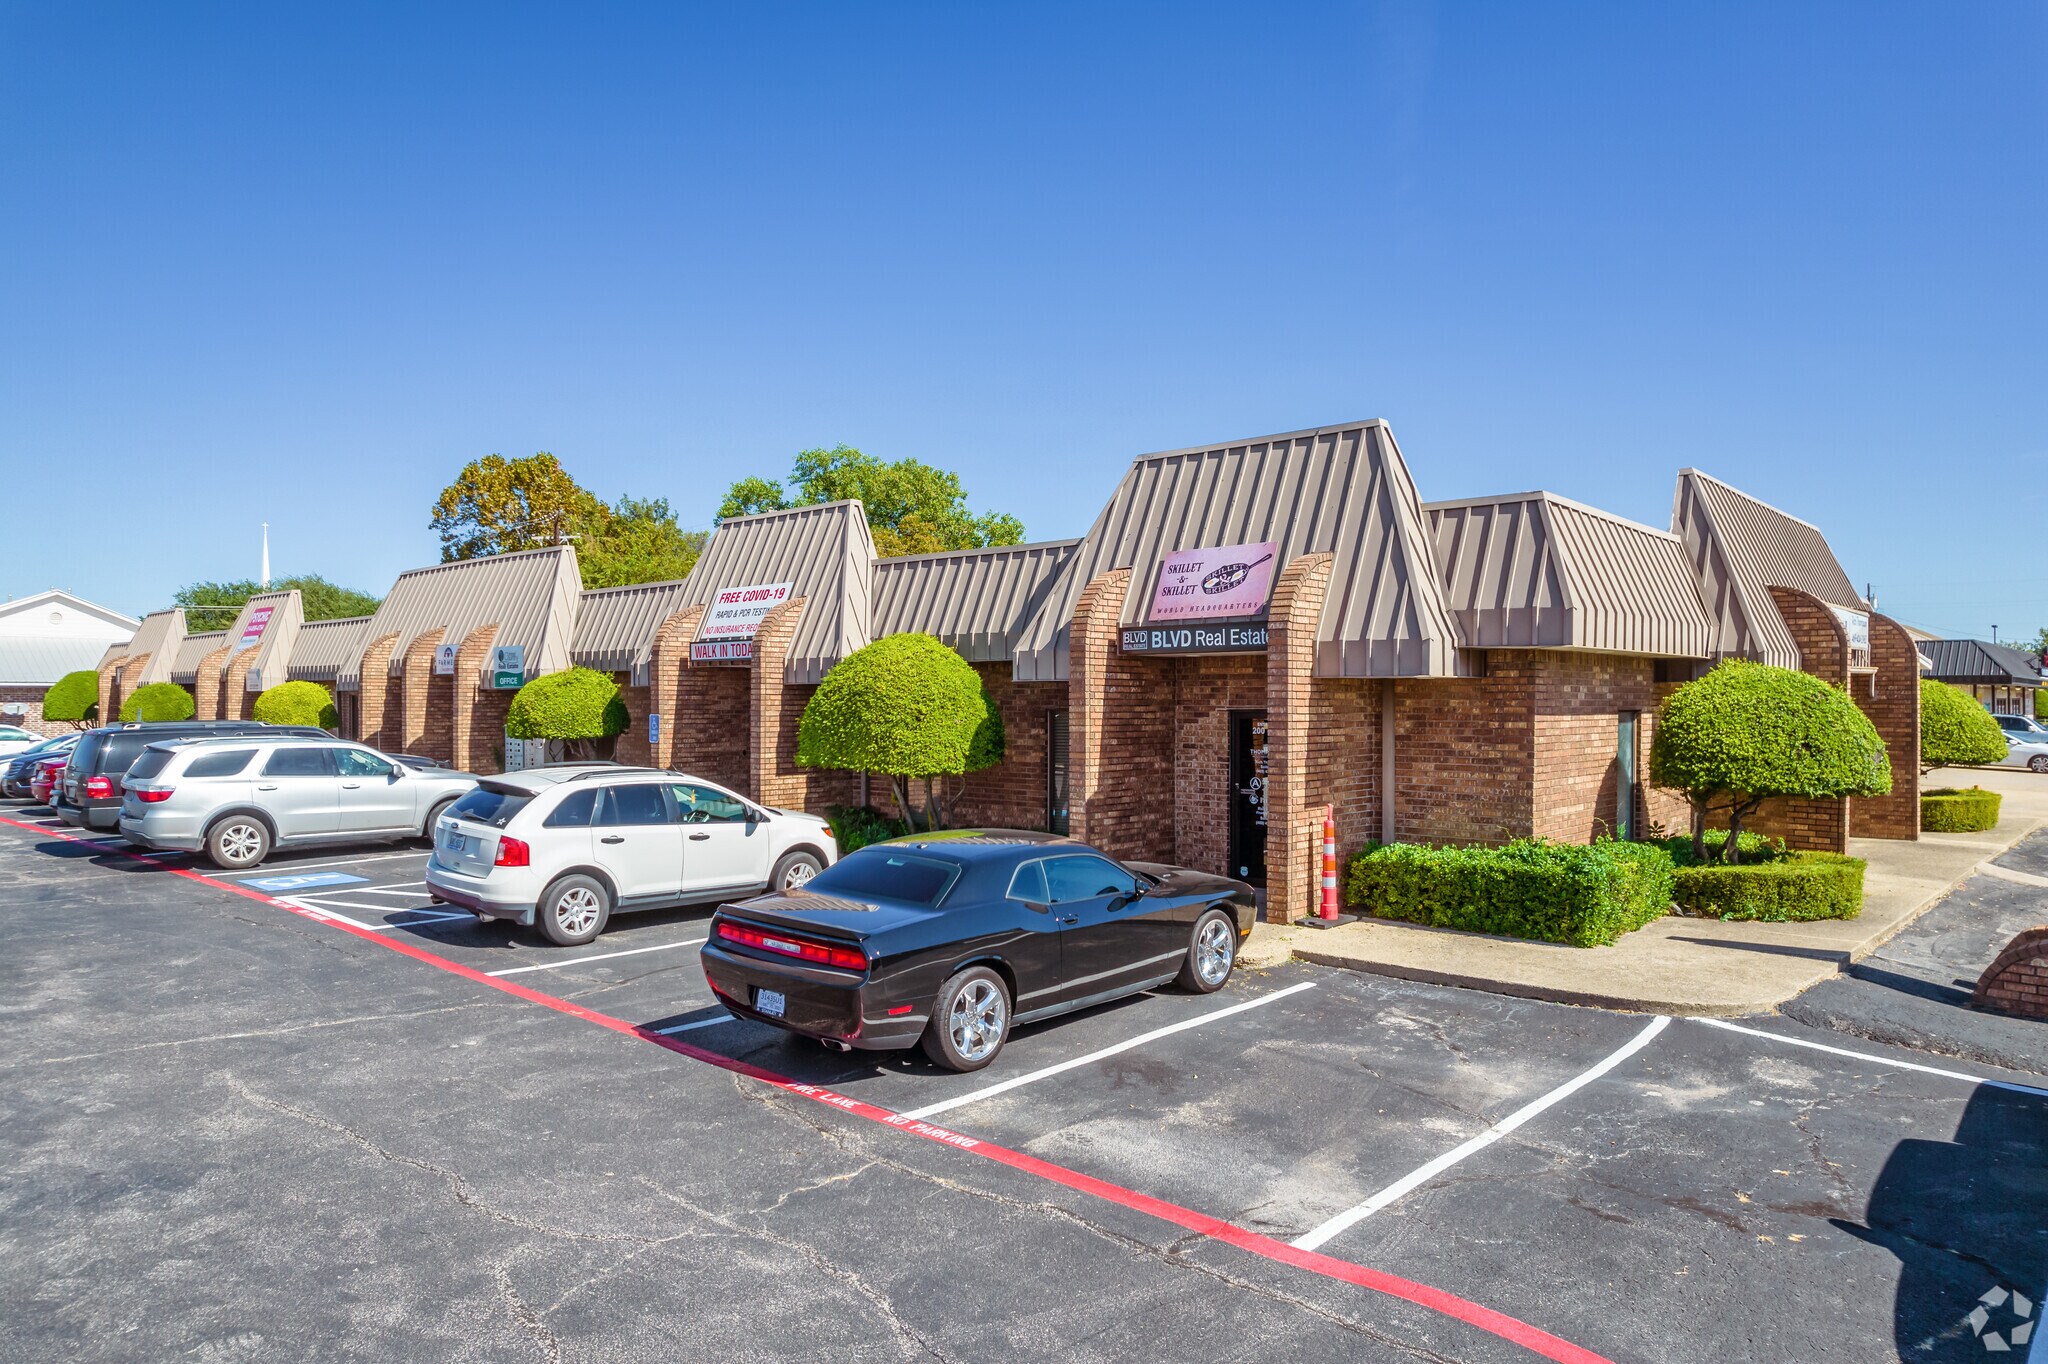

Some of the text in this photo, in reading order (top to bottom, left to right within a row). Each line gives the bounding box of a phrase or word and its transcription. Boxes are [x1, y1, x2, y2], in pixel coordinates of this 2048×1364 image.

[1167, 562, 1204, 574] SKILLET
[719, 587, 786, 604] FREE COVID-19
[1162, 585, 1198, 597] SKILLET
[715, 609, 733, 619] RAPID
[738, 608, 752, 617] PCR
[1157, 602, 1259, 614] WORLD HEADQUARTERS
[705, 625, 714, 634] NO
[713, 623, 746, 634] INSURANCE
[1124, 632, 1146, 643] BLVD
[1151, 630, 1192, 648] BLVD
[1195, 629, 1226, 647] Real
[694, 643, 752, 659] WALK IN TODA
[499, 677, 518, 685] OFFICE
[818, 1093, 862, 1109] LANE
[883, 1113, 981, 1148] NO PARKING
